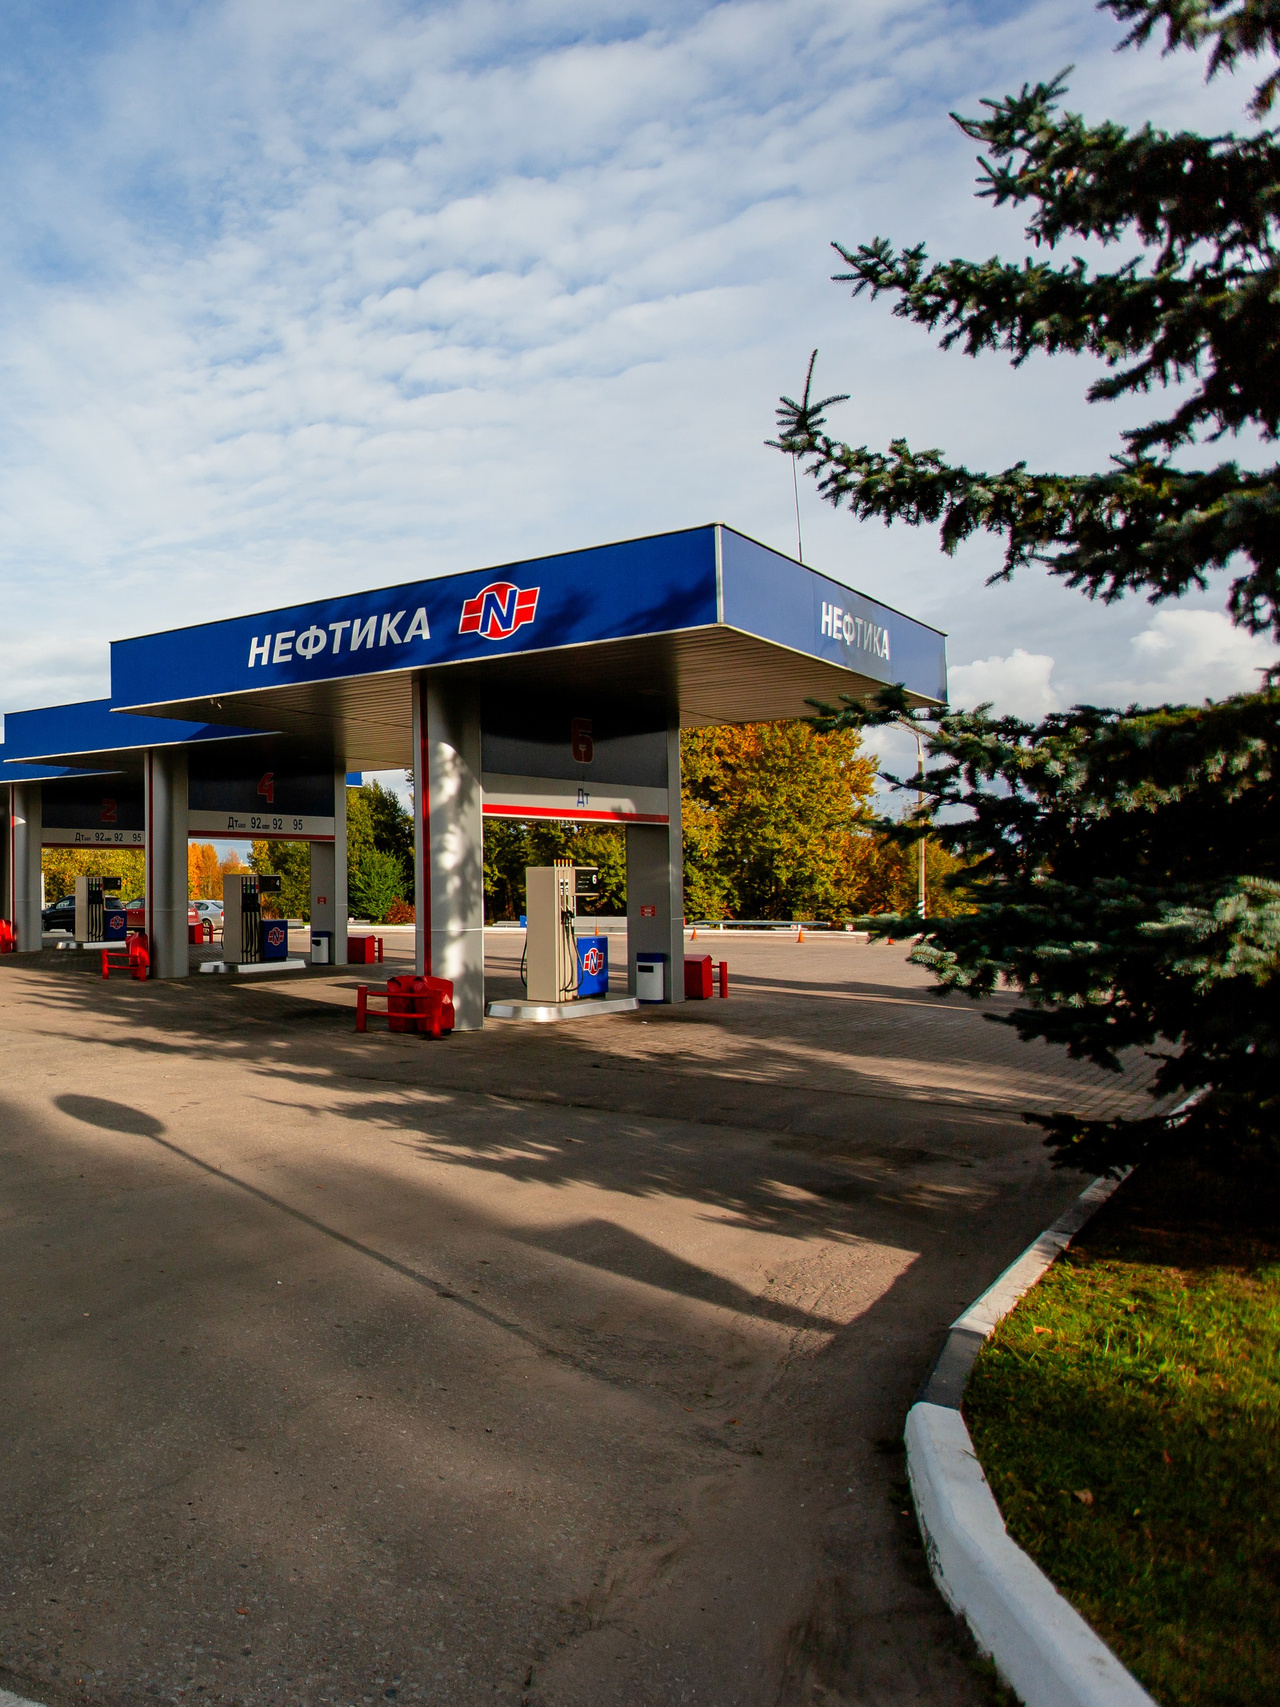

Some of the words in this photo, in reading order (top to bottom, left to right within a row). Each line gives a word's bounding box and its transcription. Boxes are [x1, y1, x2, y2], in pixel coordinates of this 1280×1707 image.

[479, 587, 518, 635] N
[247, 606, 431, 668] НЕФТИКА
[821, 601, 890, 660] НЕФТИКА
[571, 717, 595, 764] 6
[257, 772, 275, 804] 4
[576, 788, 590, 807] Дт
[100, 797, 118, 823] 2
[250, 817, 261, 829] 92
[272, 818, 283, 830] 92
[293, 819, 303, 831] 95
[95, 832, 105, 842] 92
[114, 833, 123, 842] 92
[132, 833, 142, 842] 95
[592, 874, 598, 884] 6
